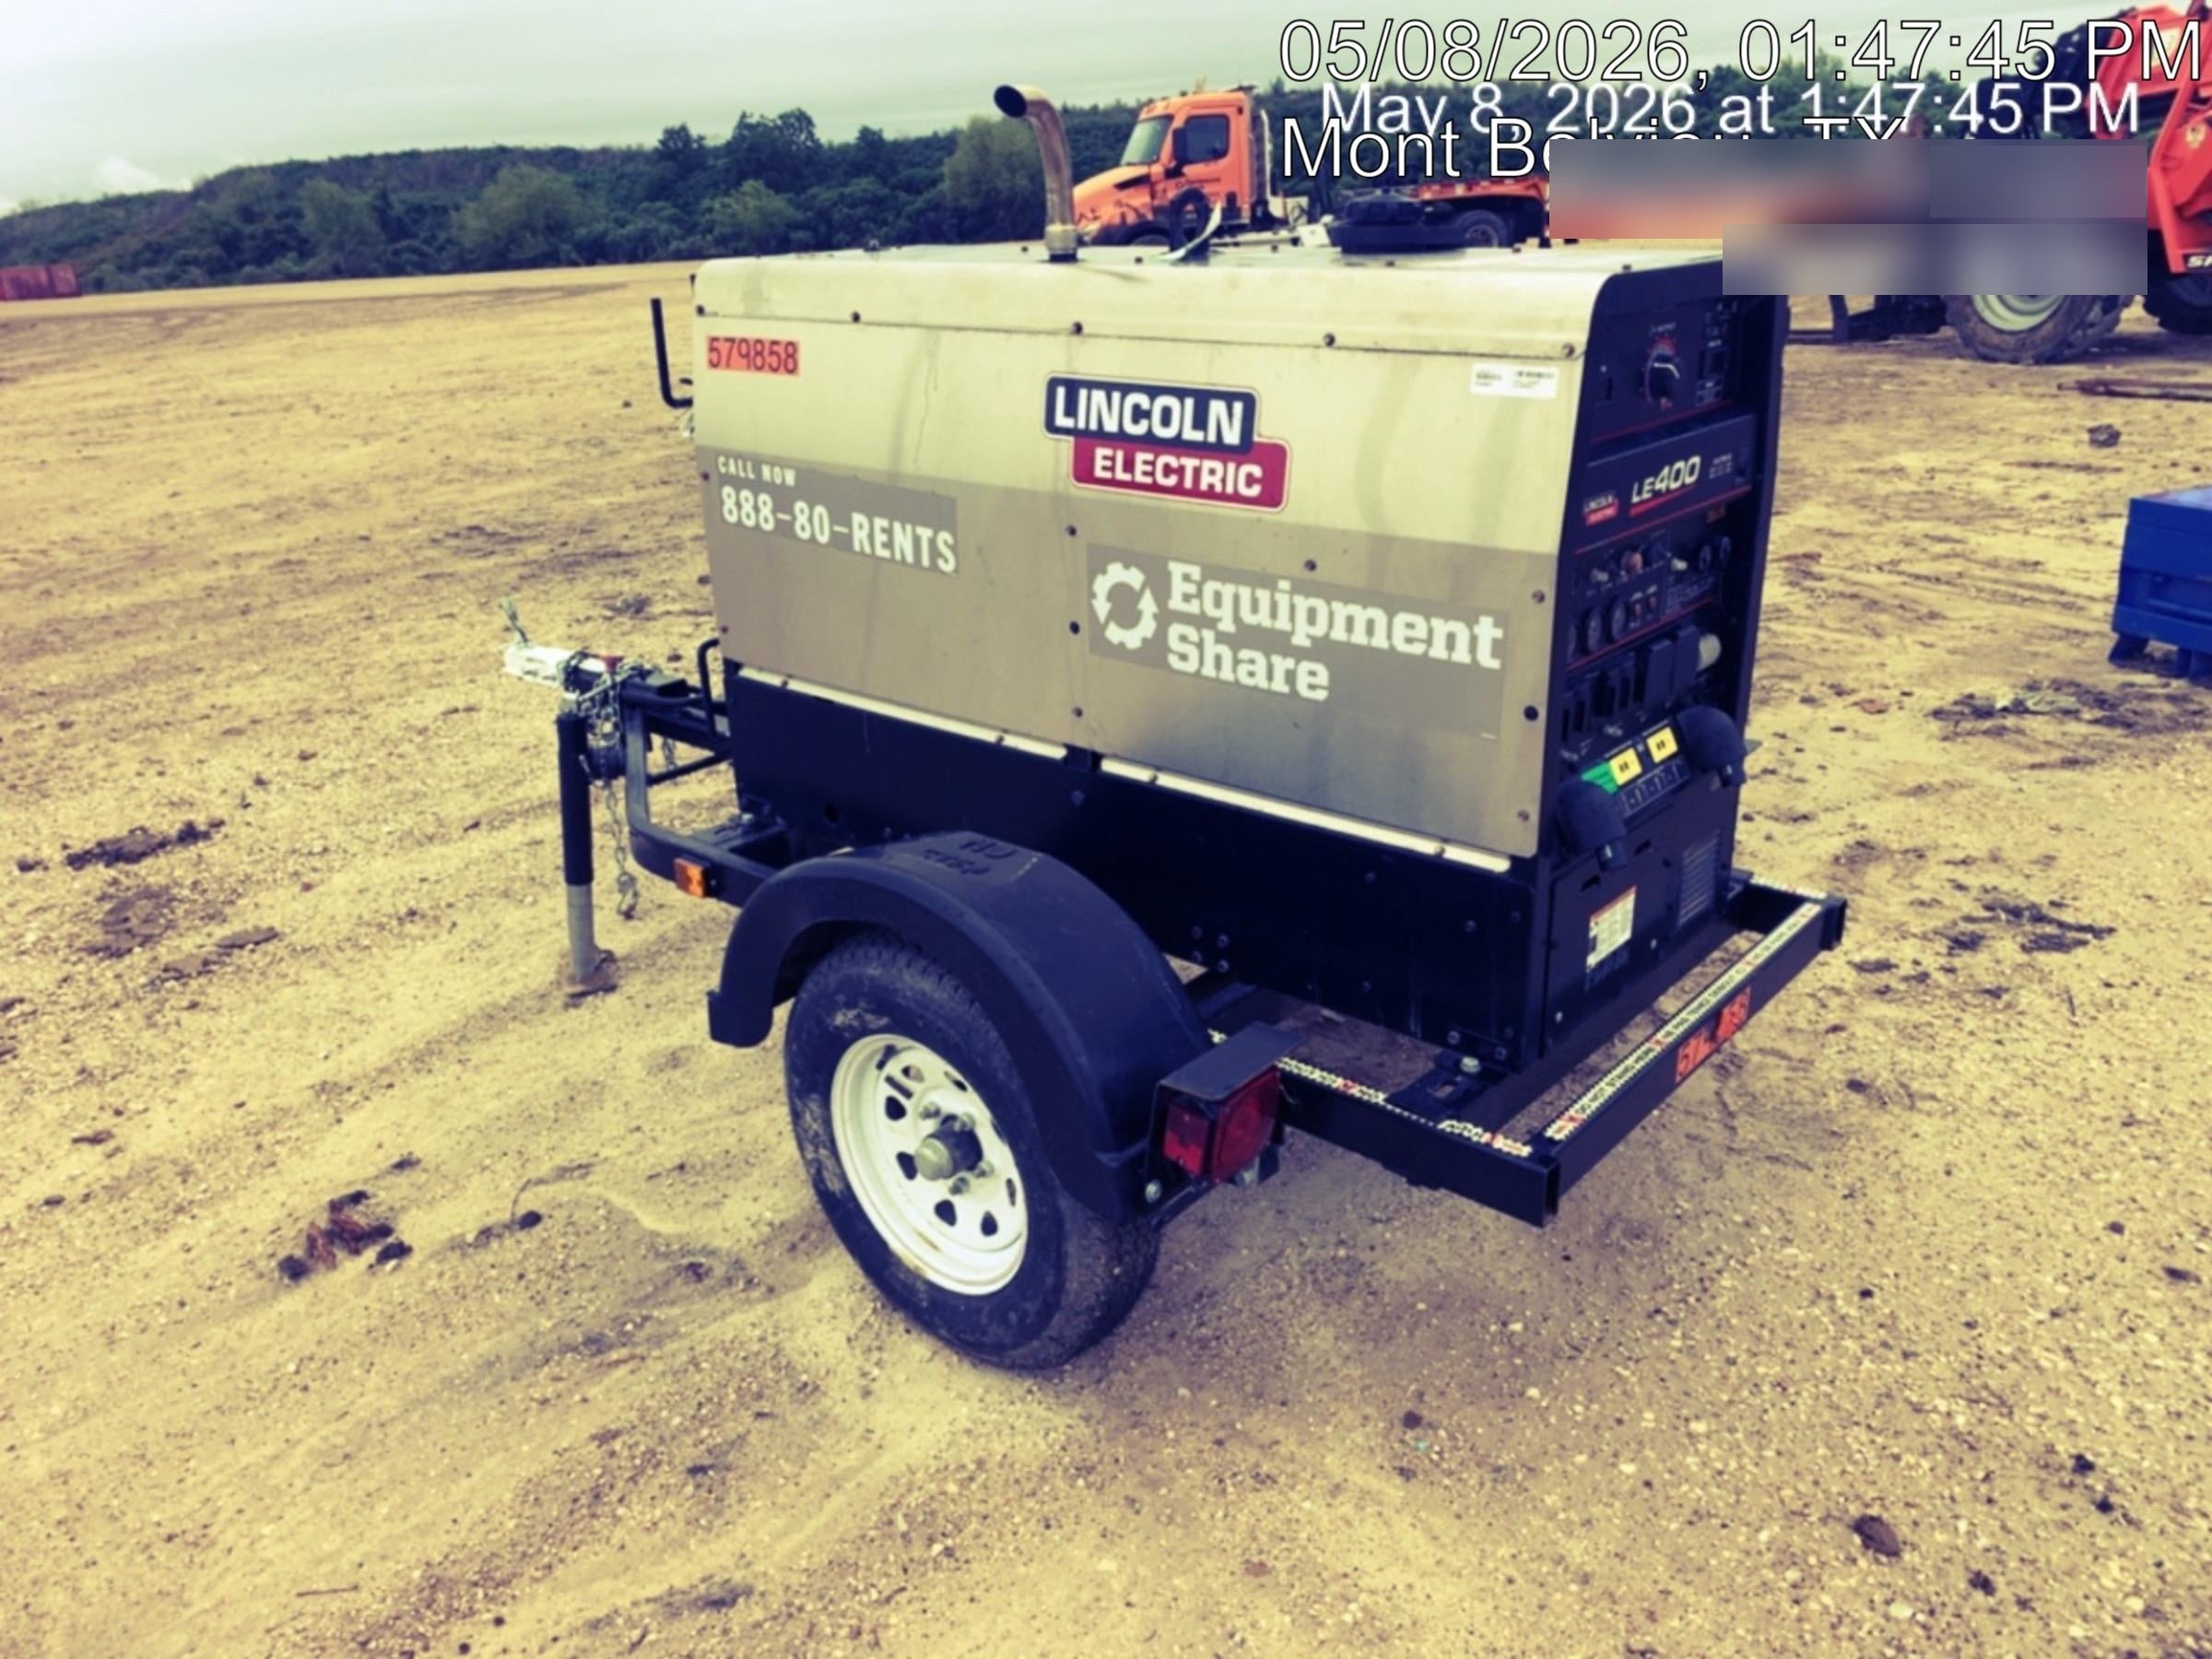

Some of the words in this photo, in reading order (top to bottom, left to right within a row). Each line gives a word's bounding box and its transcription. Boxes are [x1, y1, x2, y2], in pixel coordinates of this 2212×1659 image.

[708, 336, 798, 374] 579858
[1054, 385, 1243, 445] LINCOLN
[717, 455, 756, 480] CALL
[761, 464, 796, 488] NOW
[1094, 448, 1264, 498] ELECTRIC
[1630, 454, 1701, 504] LE400
[721, 485, 957, 573] 888-80-RENTS
[1167, 560, 1504, 670] Equipment
[1166, 622, 1330, 701] Share
